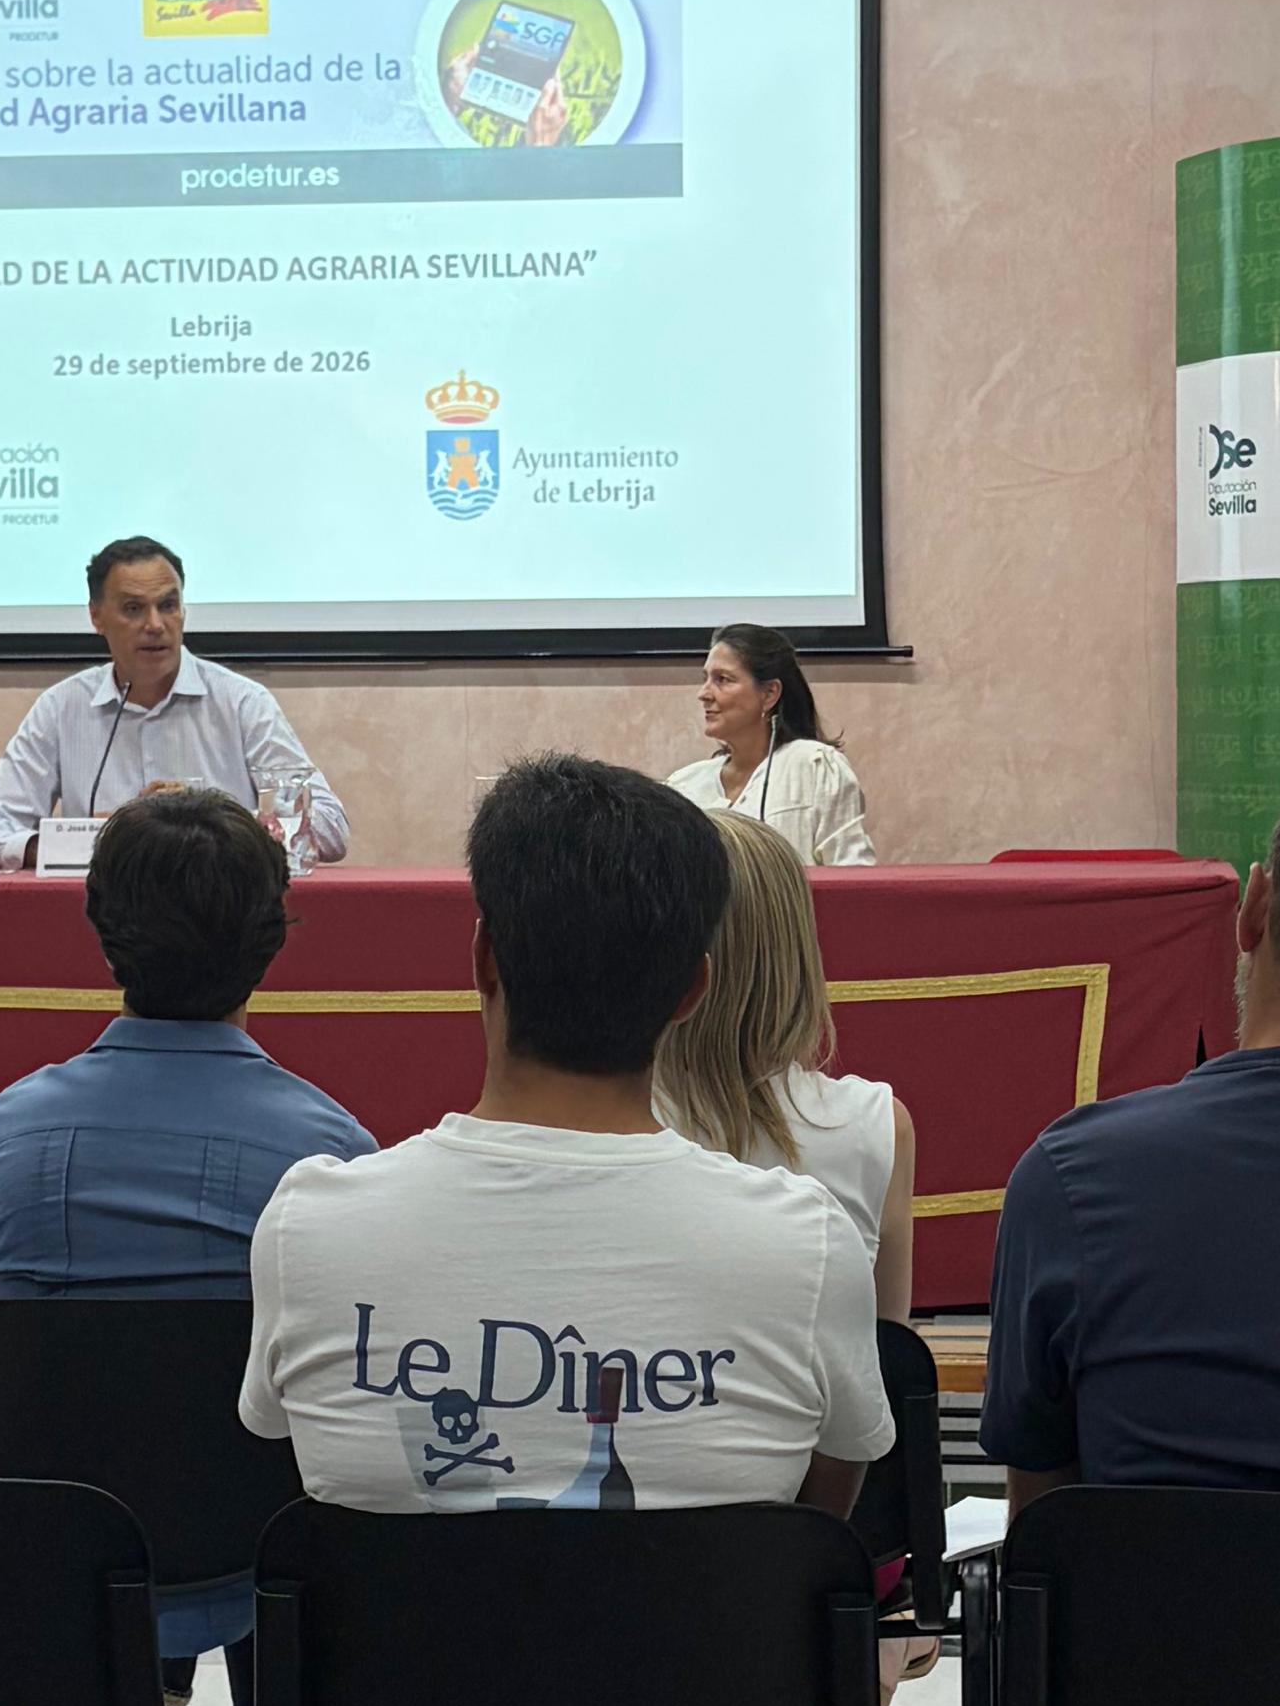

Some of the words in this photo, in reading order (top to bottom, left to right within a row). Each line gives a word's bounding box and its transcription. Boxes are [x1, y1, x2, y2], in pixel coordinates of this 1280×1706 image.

[5, 58, 96, 88] sobre
[108, 58, 134, 86] la
[144, 54, 312, 85] actualidad
[324, 53, 364, 82] de
[376, 52, 402, 81] la
[28, 95, 148, 134] Agraria
[158, 93, 307, 124] Sevillana
[181, 162, 341, 195] prodetur.es
[32, 260, 68, 285] DE
[77, 259, 113, 284] LA
[120, 256, 278, 284] ACTIVIDAD
[285, 254, 420, 281] AGRARIA
[426, 249, 598, 279] SEVILLANA”
[170, 315, 253, 342] Lebrija
[53, 354, 83, 377] 29
[89, 353, 120, 376] de
[126, 350, 267, 381] septiembre
[273, 350, 304, 373] de
[310, 350, 371, 373] 2026
[512, 445, 679, 478] Ayuntamiento
[533, 480, 561, 504] de
[568, 479, 656, 510] Lebrija
[1208, 494, 1257, 517] Sevilla
[351, 1302, 451, 1403] Le
[478, 1318, 736, 1414] Dîner
